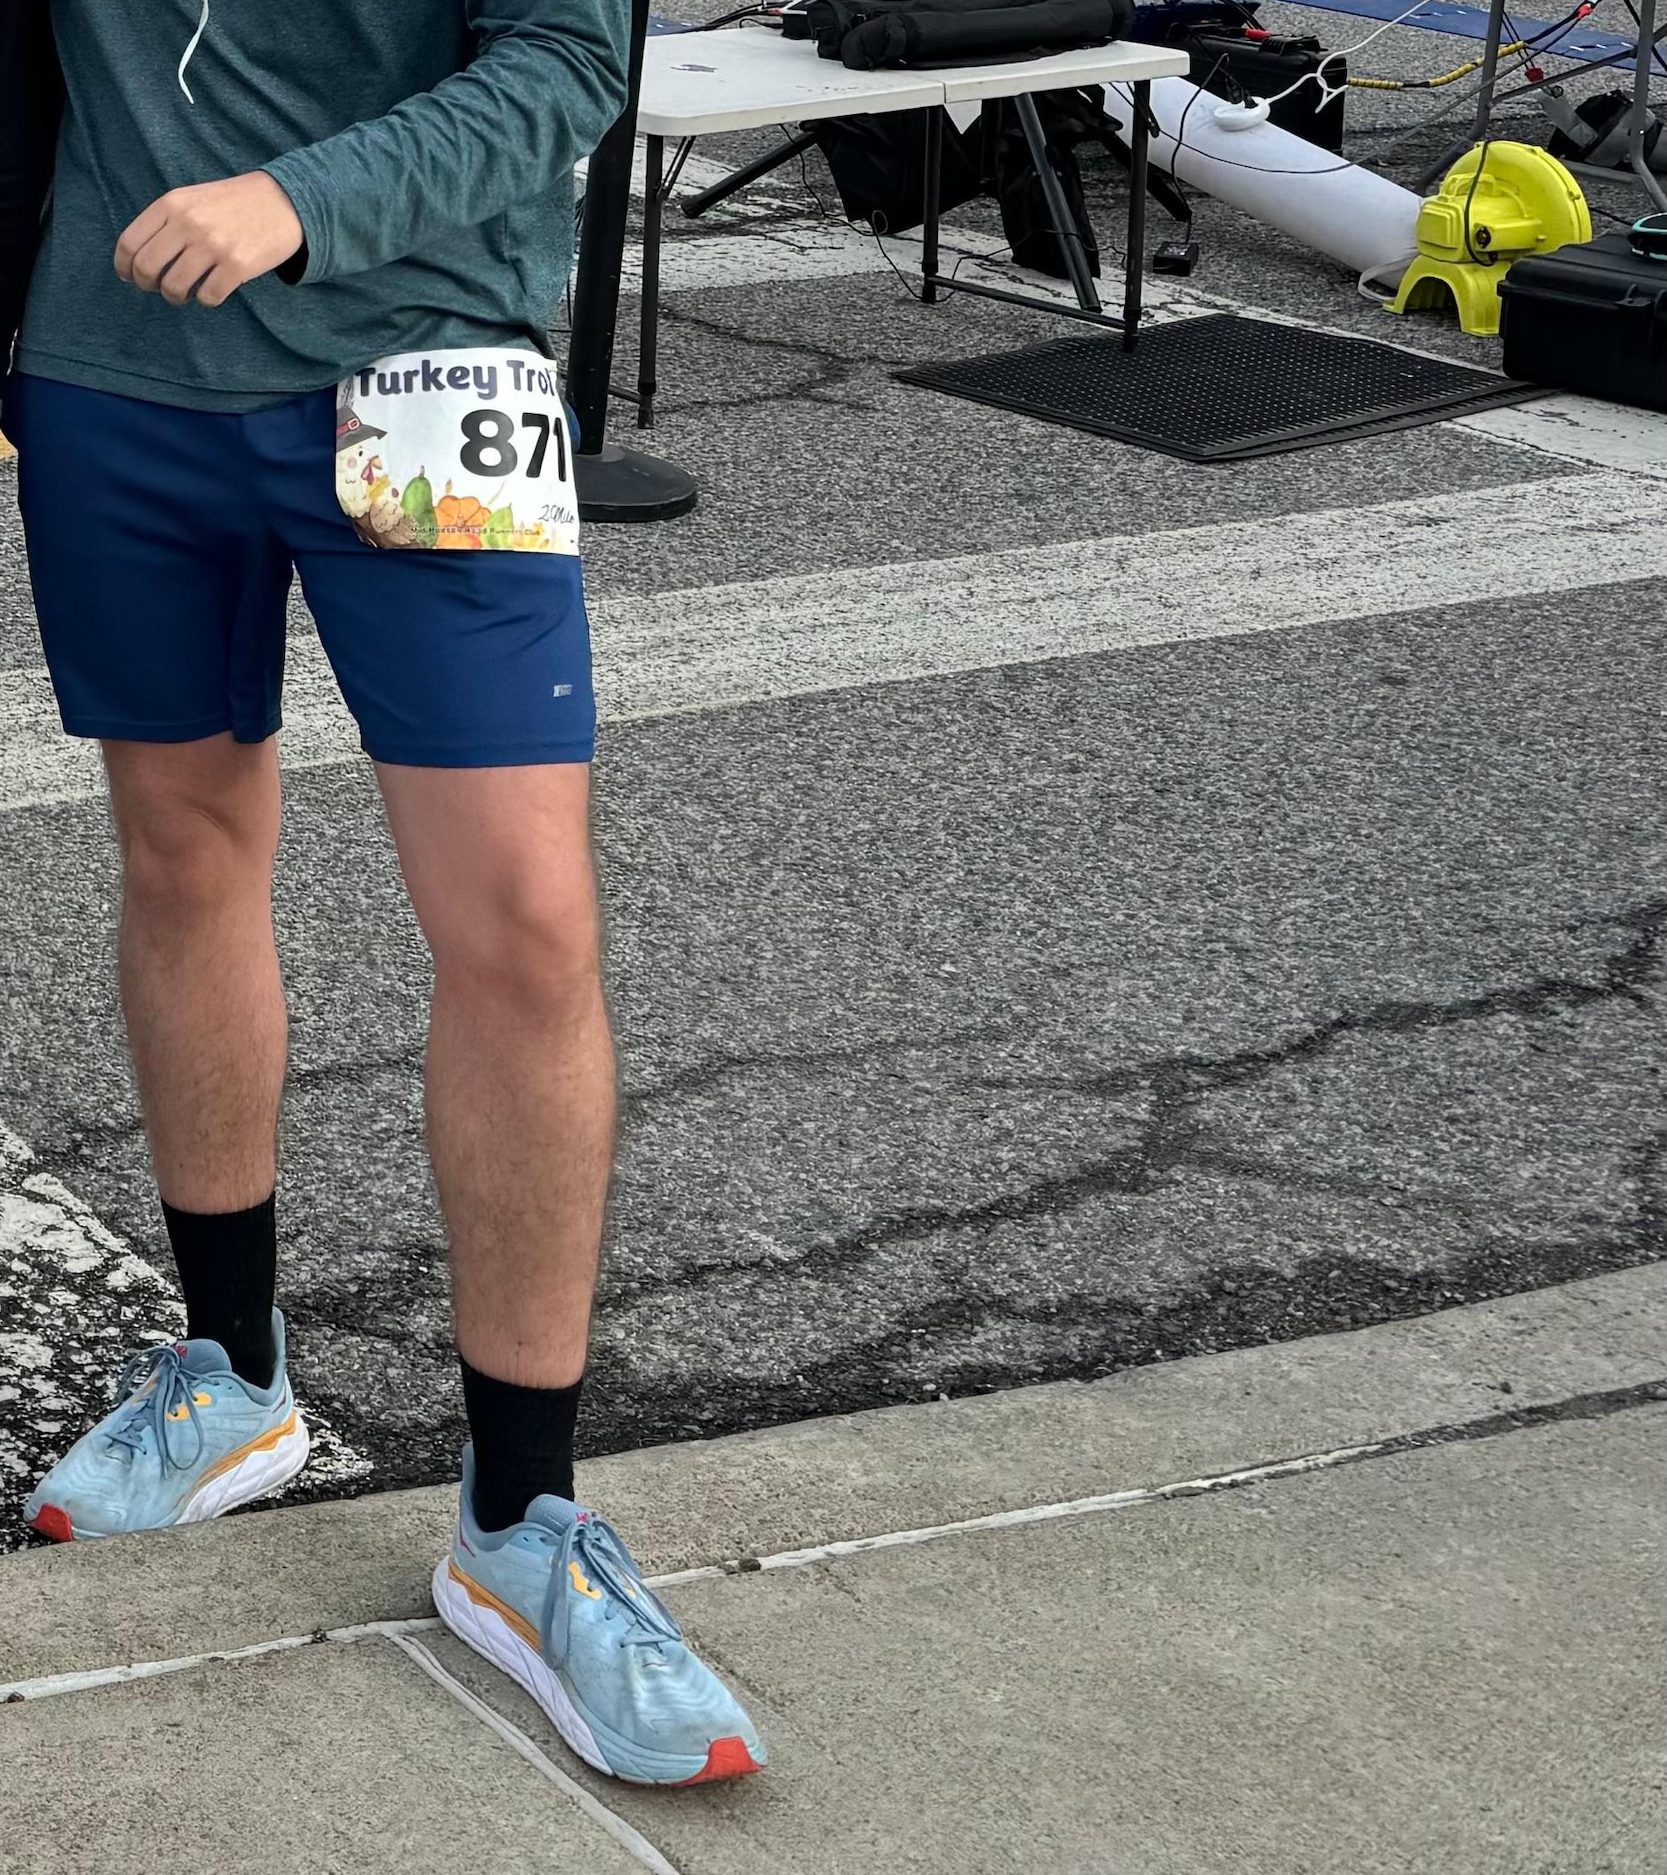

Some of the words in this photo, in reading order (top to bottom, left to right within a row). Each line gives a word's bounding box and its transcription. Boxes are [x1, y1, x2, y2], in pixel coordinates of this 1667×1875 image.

[355, 360, 498, 400] Turkey
[459, 409, 567, 482] 871
[539, 504, 550, 522] 2
